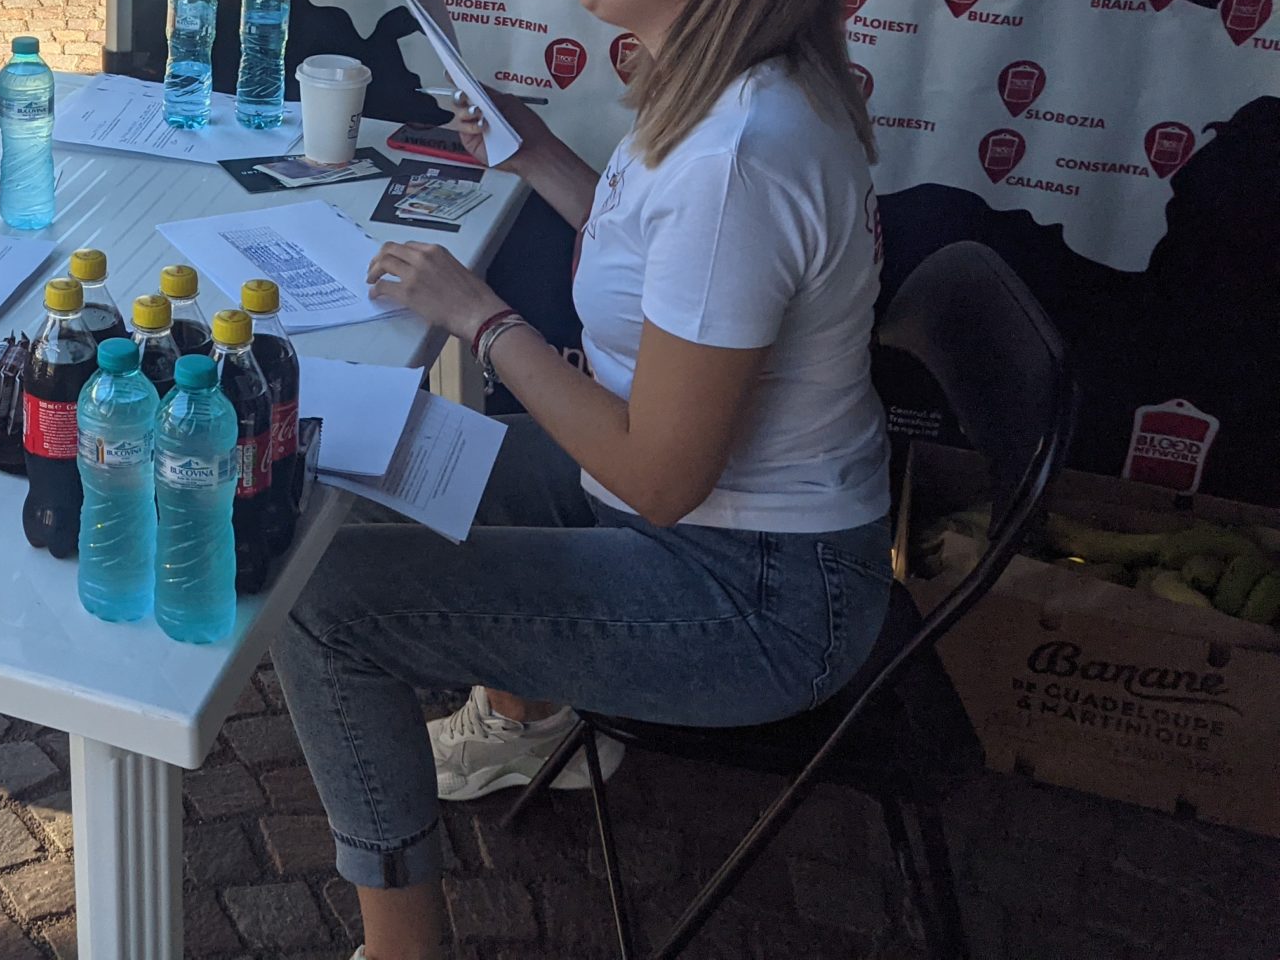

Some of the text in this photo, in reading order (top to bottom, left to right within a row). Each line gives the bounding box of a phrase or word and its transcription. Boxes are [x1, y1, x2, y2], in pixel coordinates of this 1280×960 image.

[448, 11, 549, 34] URNU SEVERIN
[853, 15, 918, 34] PLOIESTI
[967, 10, 1024, 27] BUZAU
[847, 31, 877, 46] ISTE
[1252, 37, 1280, 51] TUL
[494, 71, 553, 89] CRAIOVA
[1024, 108, 1106, 130] SLOBOZIA
[1055, 157, 1150, 178] CONSTANTA
[1005, 175, 1080, 196] CALARASI
[107, 448, 141, 457] BUCOVINA
[1135, 434, 1201, 454] BLOOD
[1133, 446, 1199, 464] NETWORK
[170, 466, 214, 477] BUCOVINA
[1027, 640, 1232, 704] Banane
[1044, 683, 1224, 736] GUADELOUPE
[1040, 700, 1209, 751] MARTINIQUE
